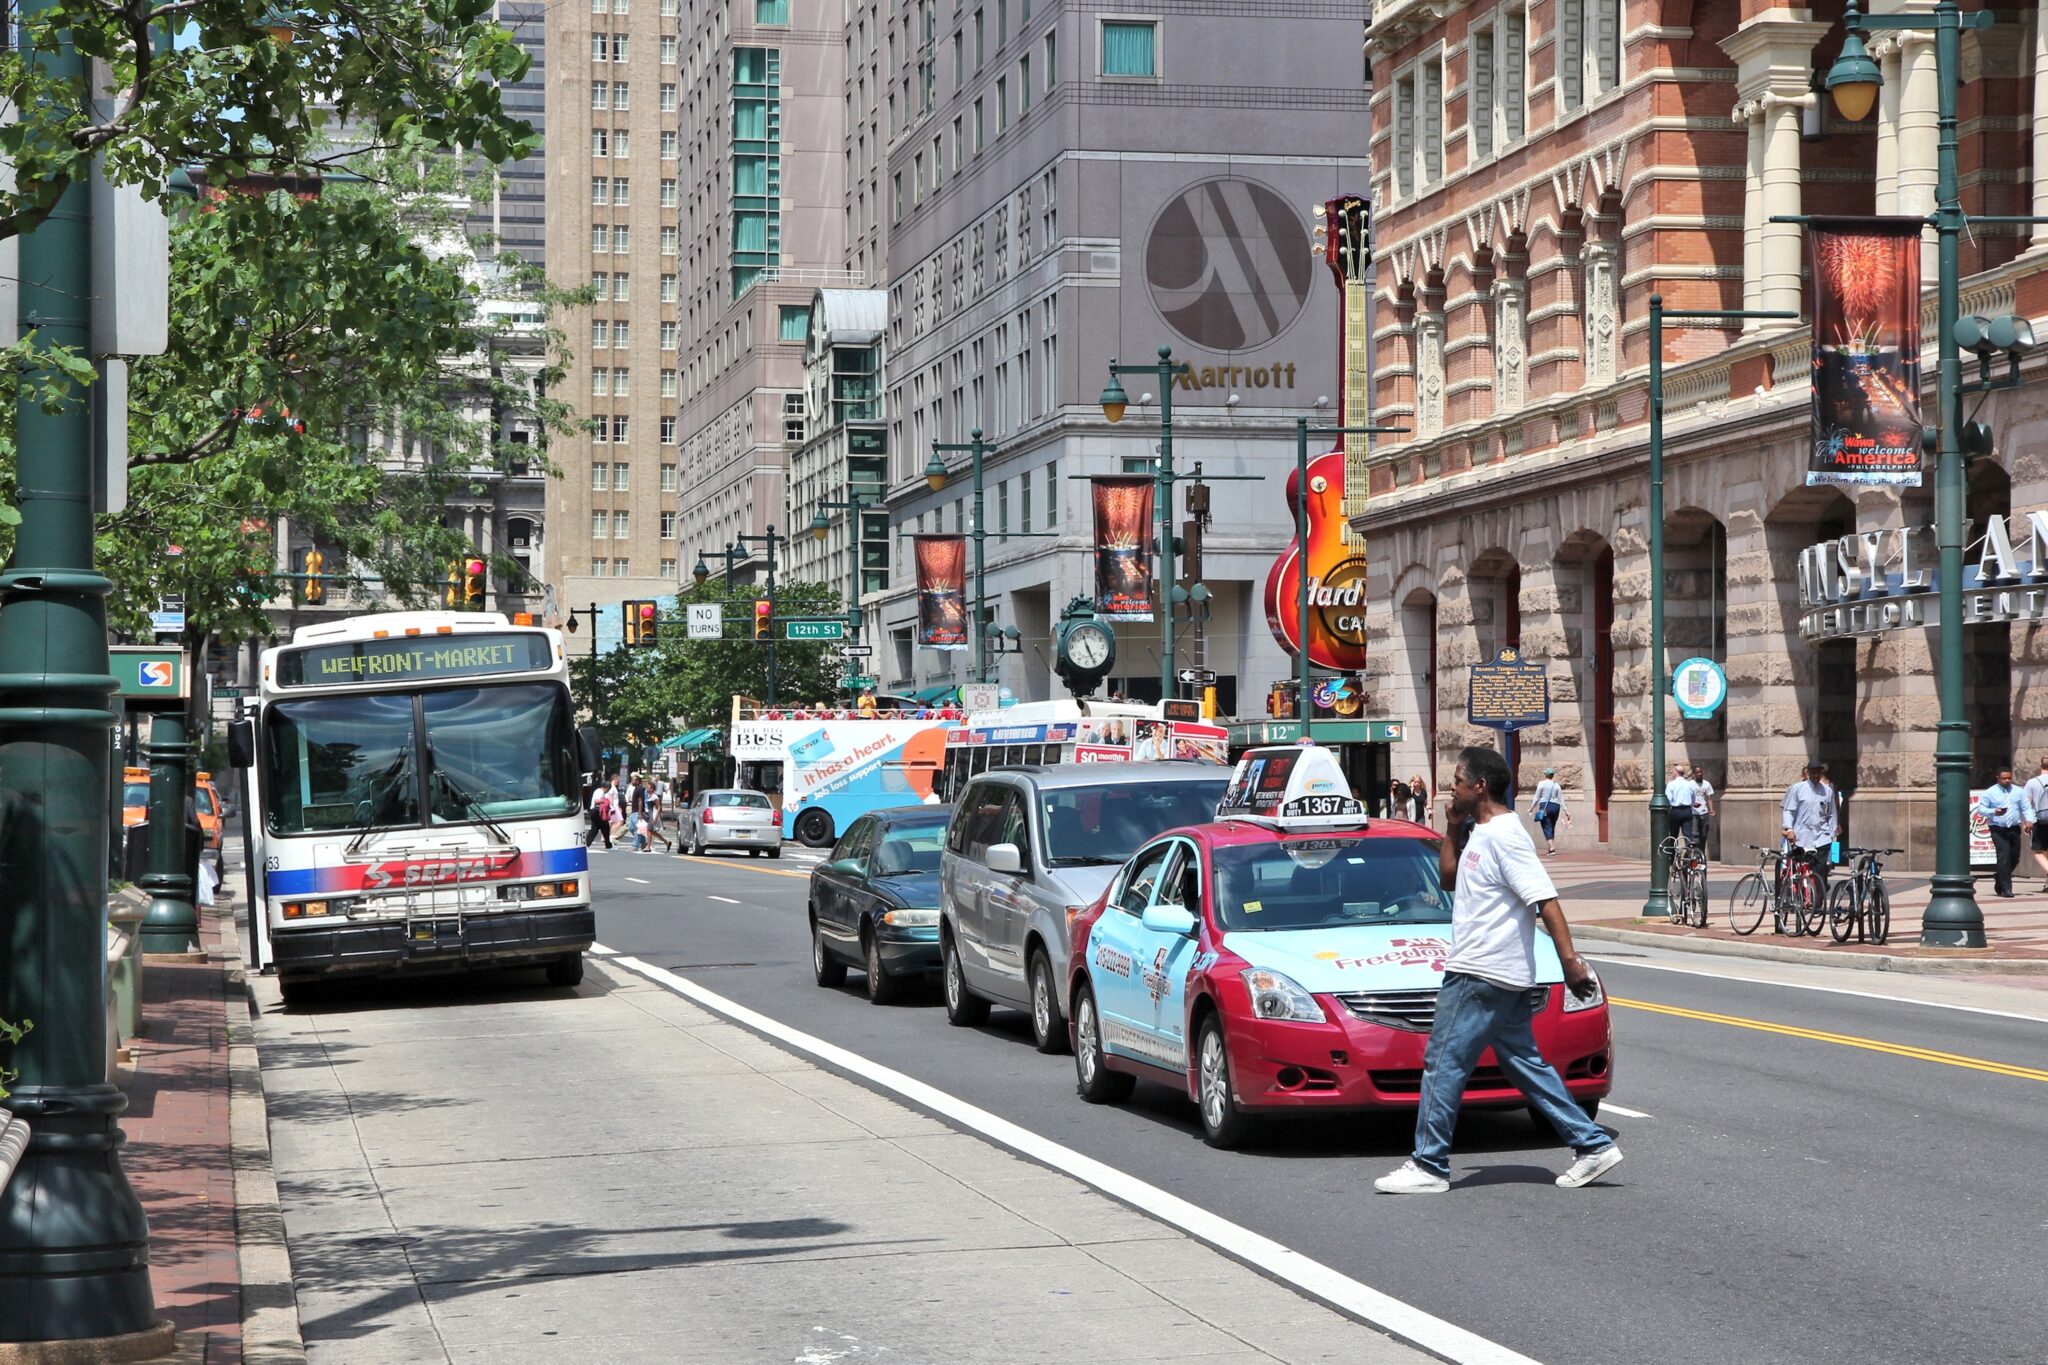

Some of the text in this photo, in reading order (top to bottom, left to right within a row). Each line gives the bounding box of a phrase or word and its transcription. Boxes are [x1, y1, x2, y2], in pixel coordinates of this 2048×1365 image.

[1171, 360, 1296, 391] Marriott
[1845, 437, 1876, 447] Wawa
[1859, 445, 1913, 455] welcome
[1834, 451, 1917, 464] America
[1798, 510, 2048, 606] NNSYLAN
[1962, 590, 2040, 618] ENT
[696, 609, 713, 620] NO
[690, 624, 720, 634] TURNS
[1338, 615, 1367, 631] CA
[794, 625, 837, 635] 12th St
[737, 733, 783, 746] BUS
[803, 733, 897, 786] It has a heart.
[1098, 753, 1125, 763] monthly
[814, 760, 881, 800] Job loss support
[1288, 801, 1299, 809] OFF
[1301, 797, 1341, 814] 1367
[267, 856, 280, 870] 53
[403, 860, 487, 884] SEPTA
